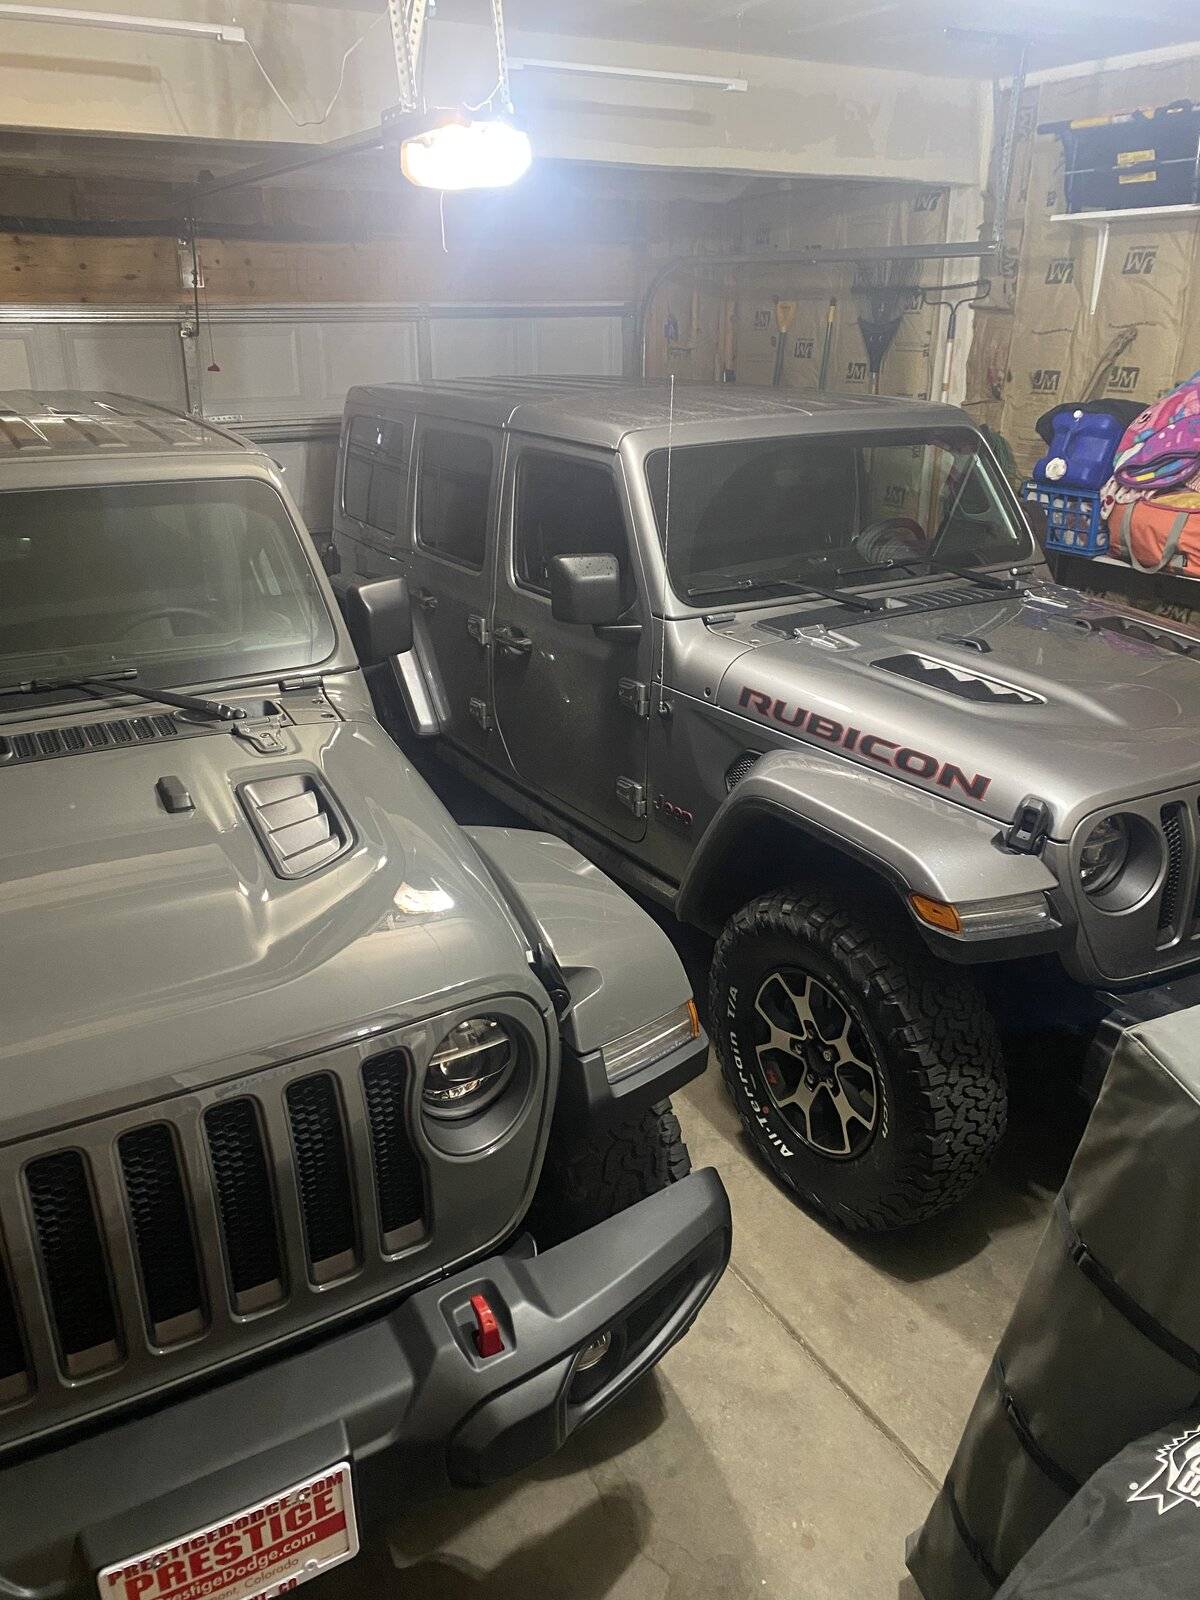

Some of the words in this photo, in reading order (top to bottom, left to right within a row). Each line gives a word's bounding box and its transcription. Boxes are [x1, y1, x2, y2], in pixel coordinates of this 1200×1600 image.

[1031, 369, 1061, 390] JM
[1108, 366, 1140, 388] JM
[738, 686, 992, 802] RUBICON
[727, 985, 738, 1018] T/A
[730, 1031, 795, 1157] All-Terrain
[124, 1490, 336, 1600] PRESTIGE
[245, 1557, 299, 1588] Colorado
